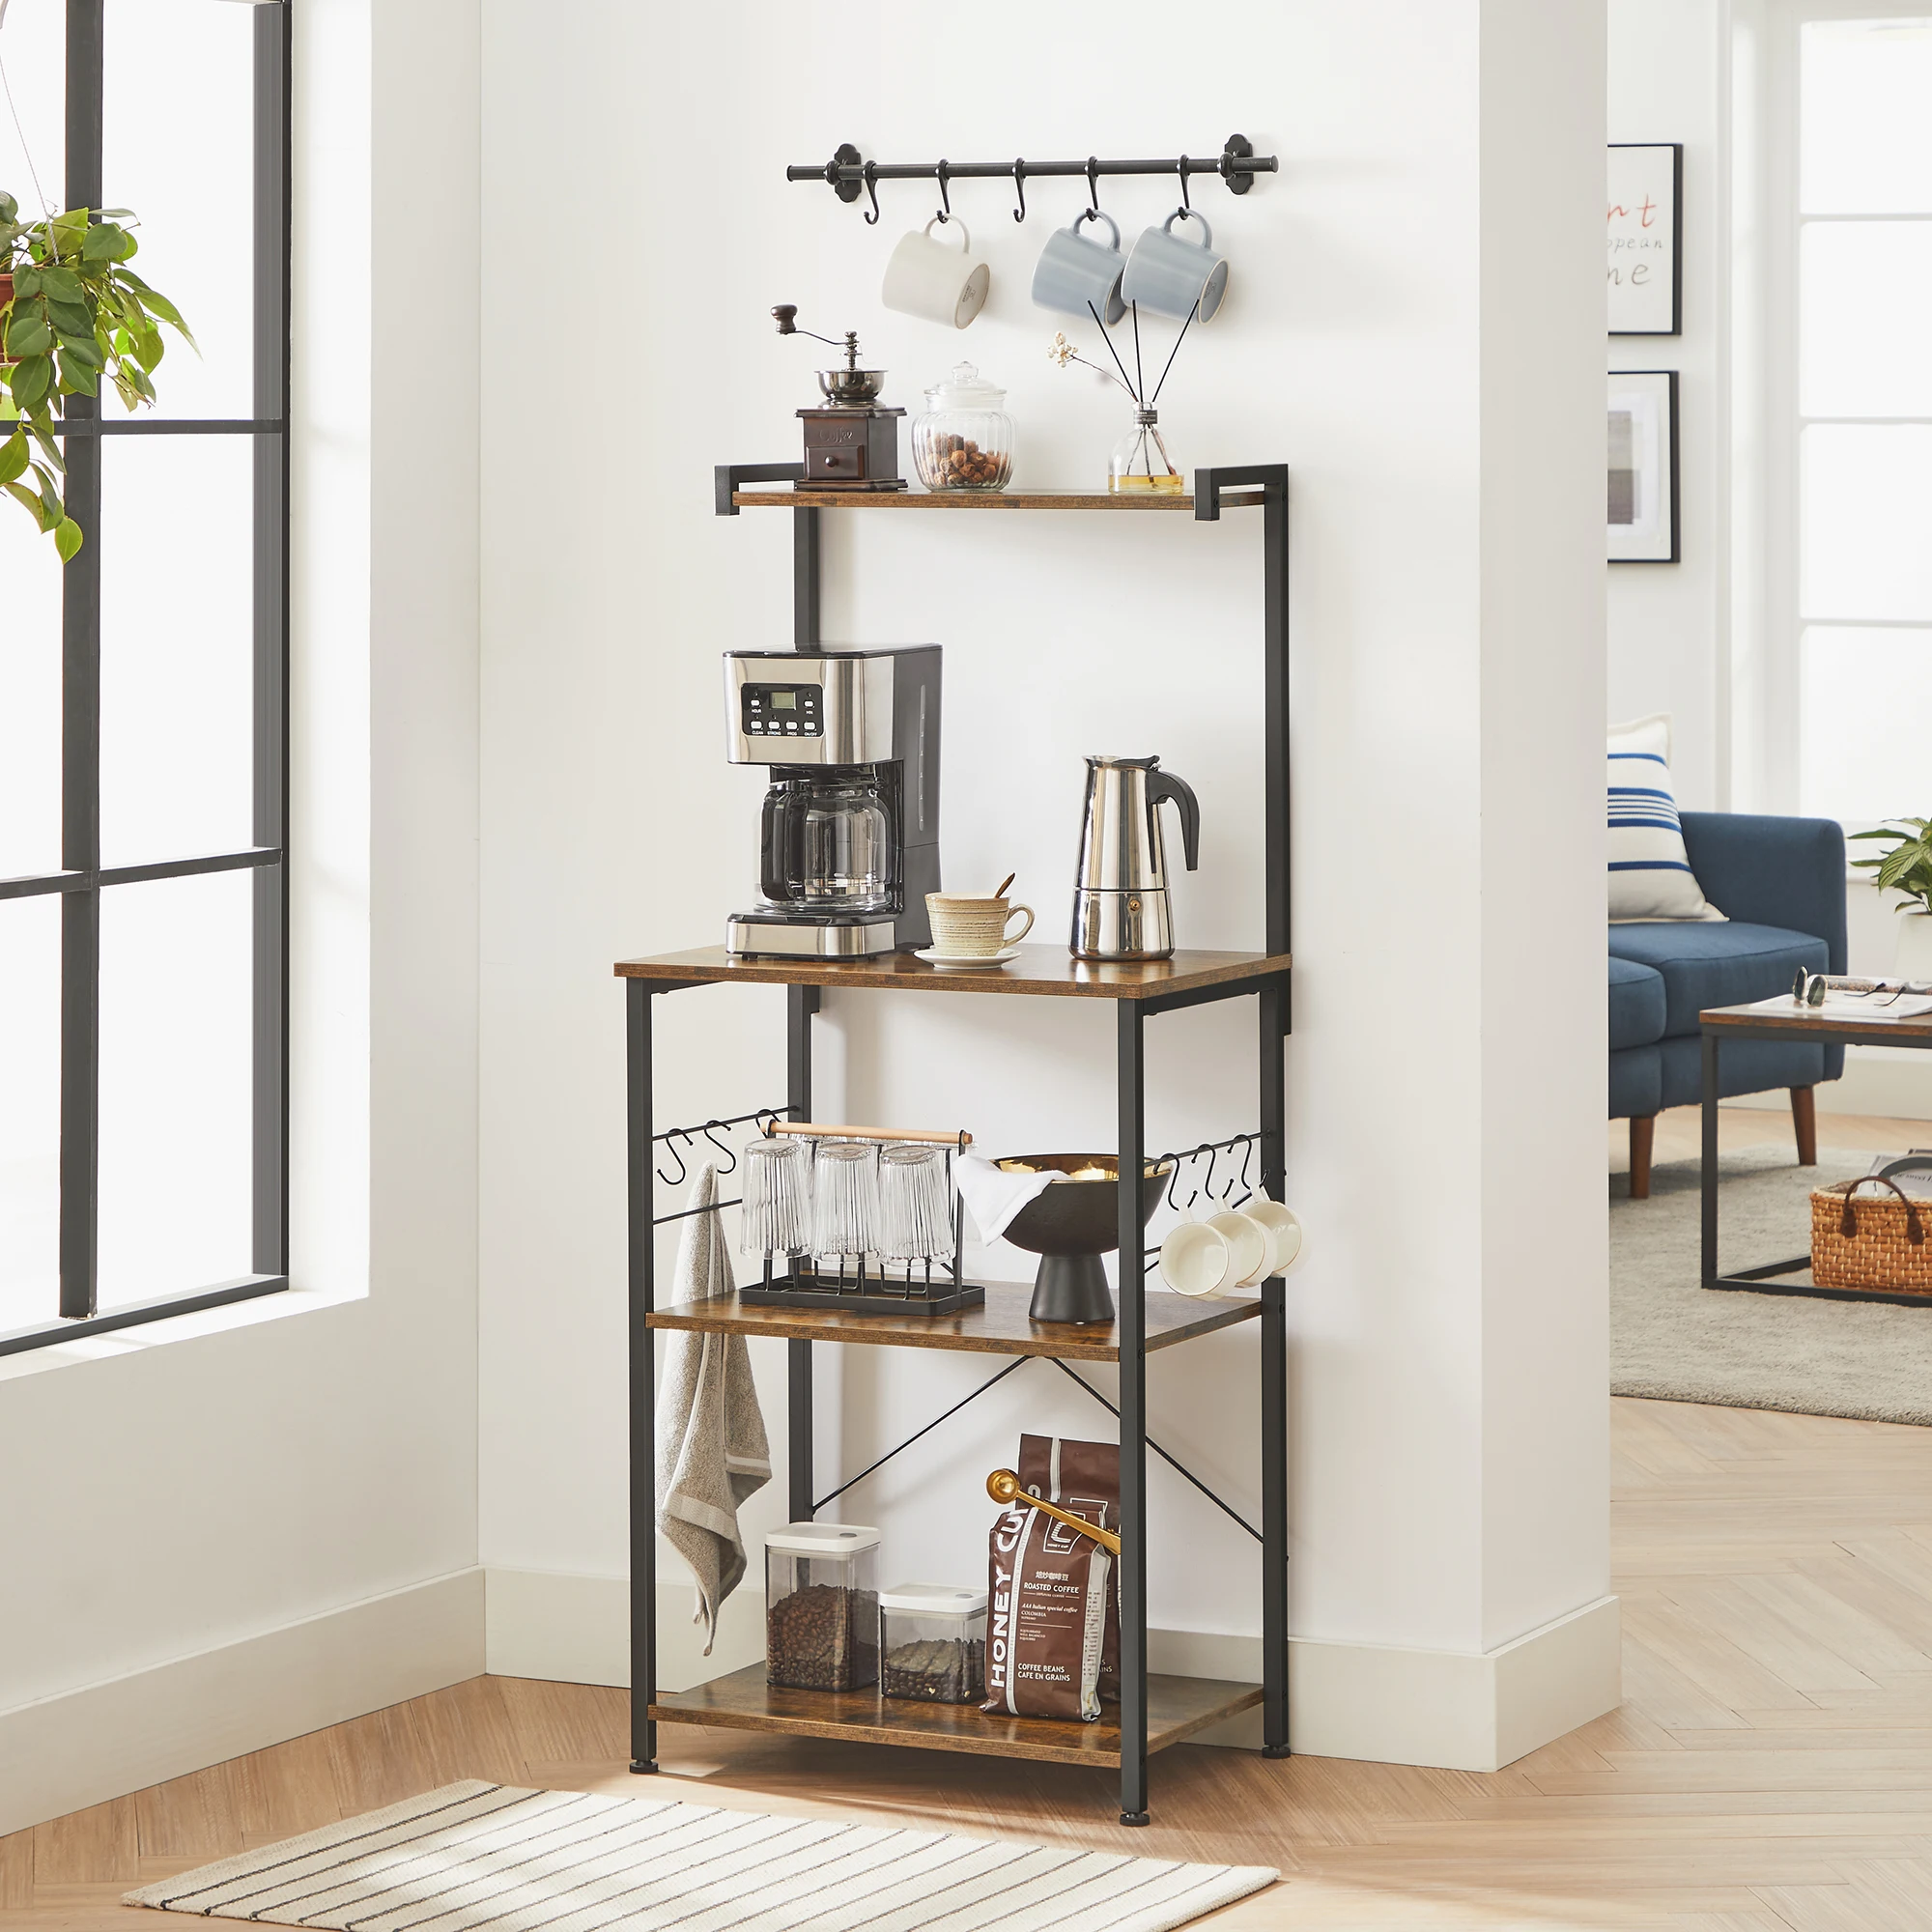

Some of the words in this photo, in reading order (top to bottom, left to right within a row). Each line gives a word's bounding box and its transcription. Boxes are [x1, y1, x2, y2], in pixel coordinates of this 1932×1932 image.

[1024, 1581, 1052, 1591] ROASTED
[1053, 1584, 1080, 1594] COFFEE
[1020, 1609, 1047, 1618] COLOMBIA
[991, 1565, 1011, 1688] HONEY
[1017, 1662, 1042, 1672] COFFEE
[1042, 1664, 1065, 1673] BEANS
[1017, 1671, 1034, 1680] CAFE
[1045, 1673, 1070, 1682] GRAINS
